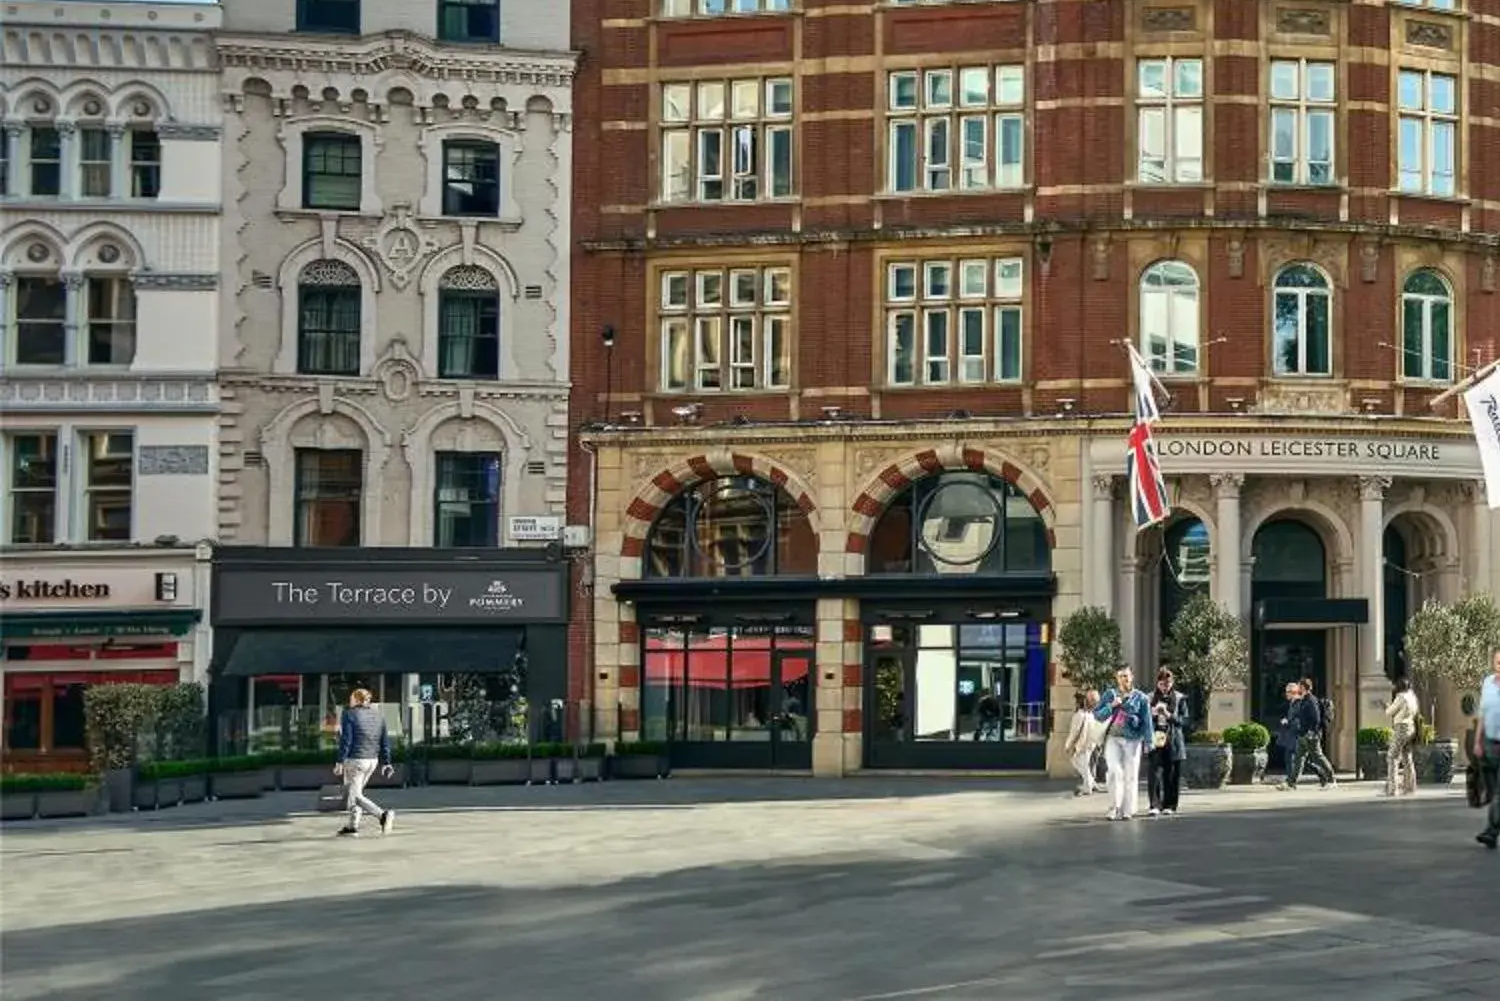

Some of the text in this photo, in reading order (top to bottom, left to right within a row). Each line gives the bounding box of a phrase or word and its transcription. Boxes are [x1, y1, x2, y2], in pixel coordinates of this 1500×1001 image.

[1157, 440, 1440, 460] LONDON LEICESTER SQUARE
[16, 579, 111, 599] kitchen
[271, 582, 452, 608] The Terrace by
